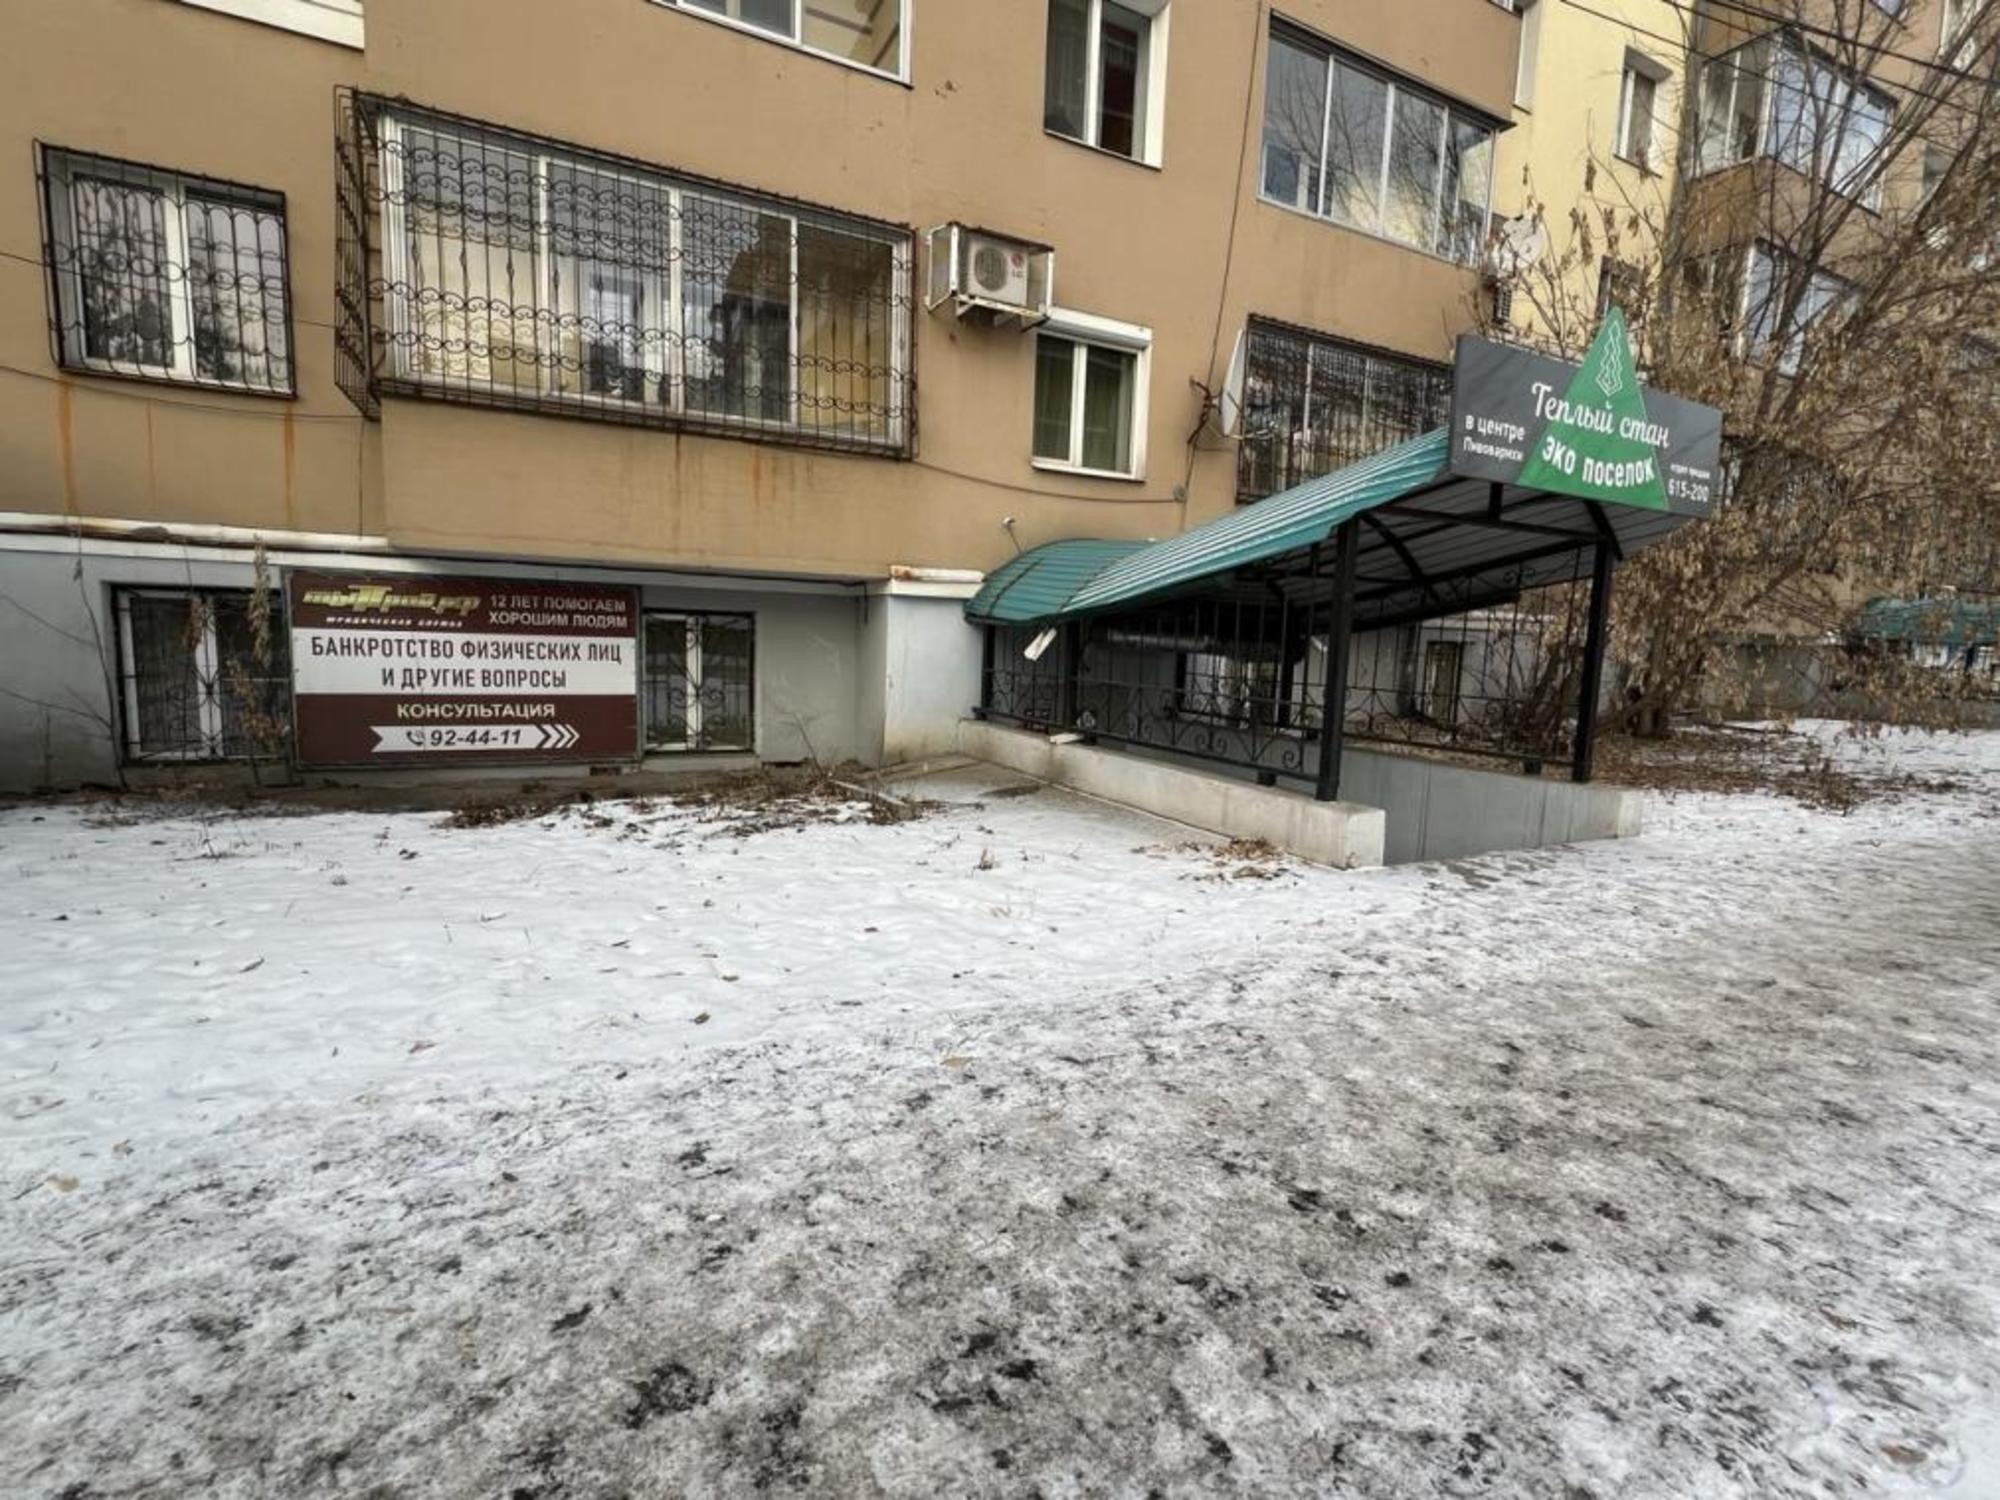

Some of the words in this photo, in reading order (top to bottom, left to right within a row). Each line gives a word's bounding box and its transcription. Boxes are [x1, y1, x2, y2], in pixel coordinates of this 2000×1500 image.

[1532, 382, 1614, 434] Теплый
[1620, 417, 1670, 448] стан
[1465, 414, 1474, 430] в
[1477, 417, 1525, 444] центре
[1582, 457, 1655, 487] поселок
[491, 595, 506, 608] 12
[511, 595, 539, 609] ЛЕТ
[543, 596, 626, 612] ПОМОГАЕМ
[489, 611, 569, 626] ХОРОШИМ
[573, 614, 628, 628] ЛЮДЯМ
[311, 636, 454, 658] БАНКРОТСТВО
[460, 640, 581, 661] ФИЗИЧЕСКИХ
[588, 643, 622, 665] ЛИЦ
[381, 668, 395, 686] И
[401, 668, 475, 689] ДРУГИЕ
[481, 669, 567, 688] ВОПРОСЫ
[397, 703, 555, 719] КОНСУЛЬТАЦИЯ
[430, 728, 522, 747] 92-44-11
